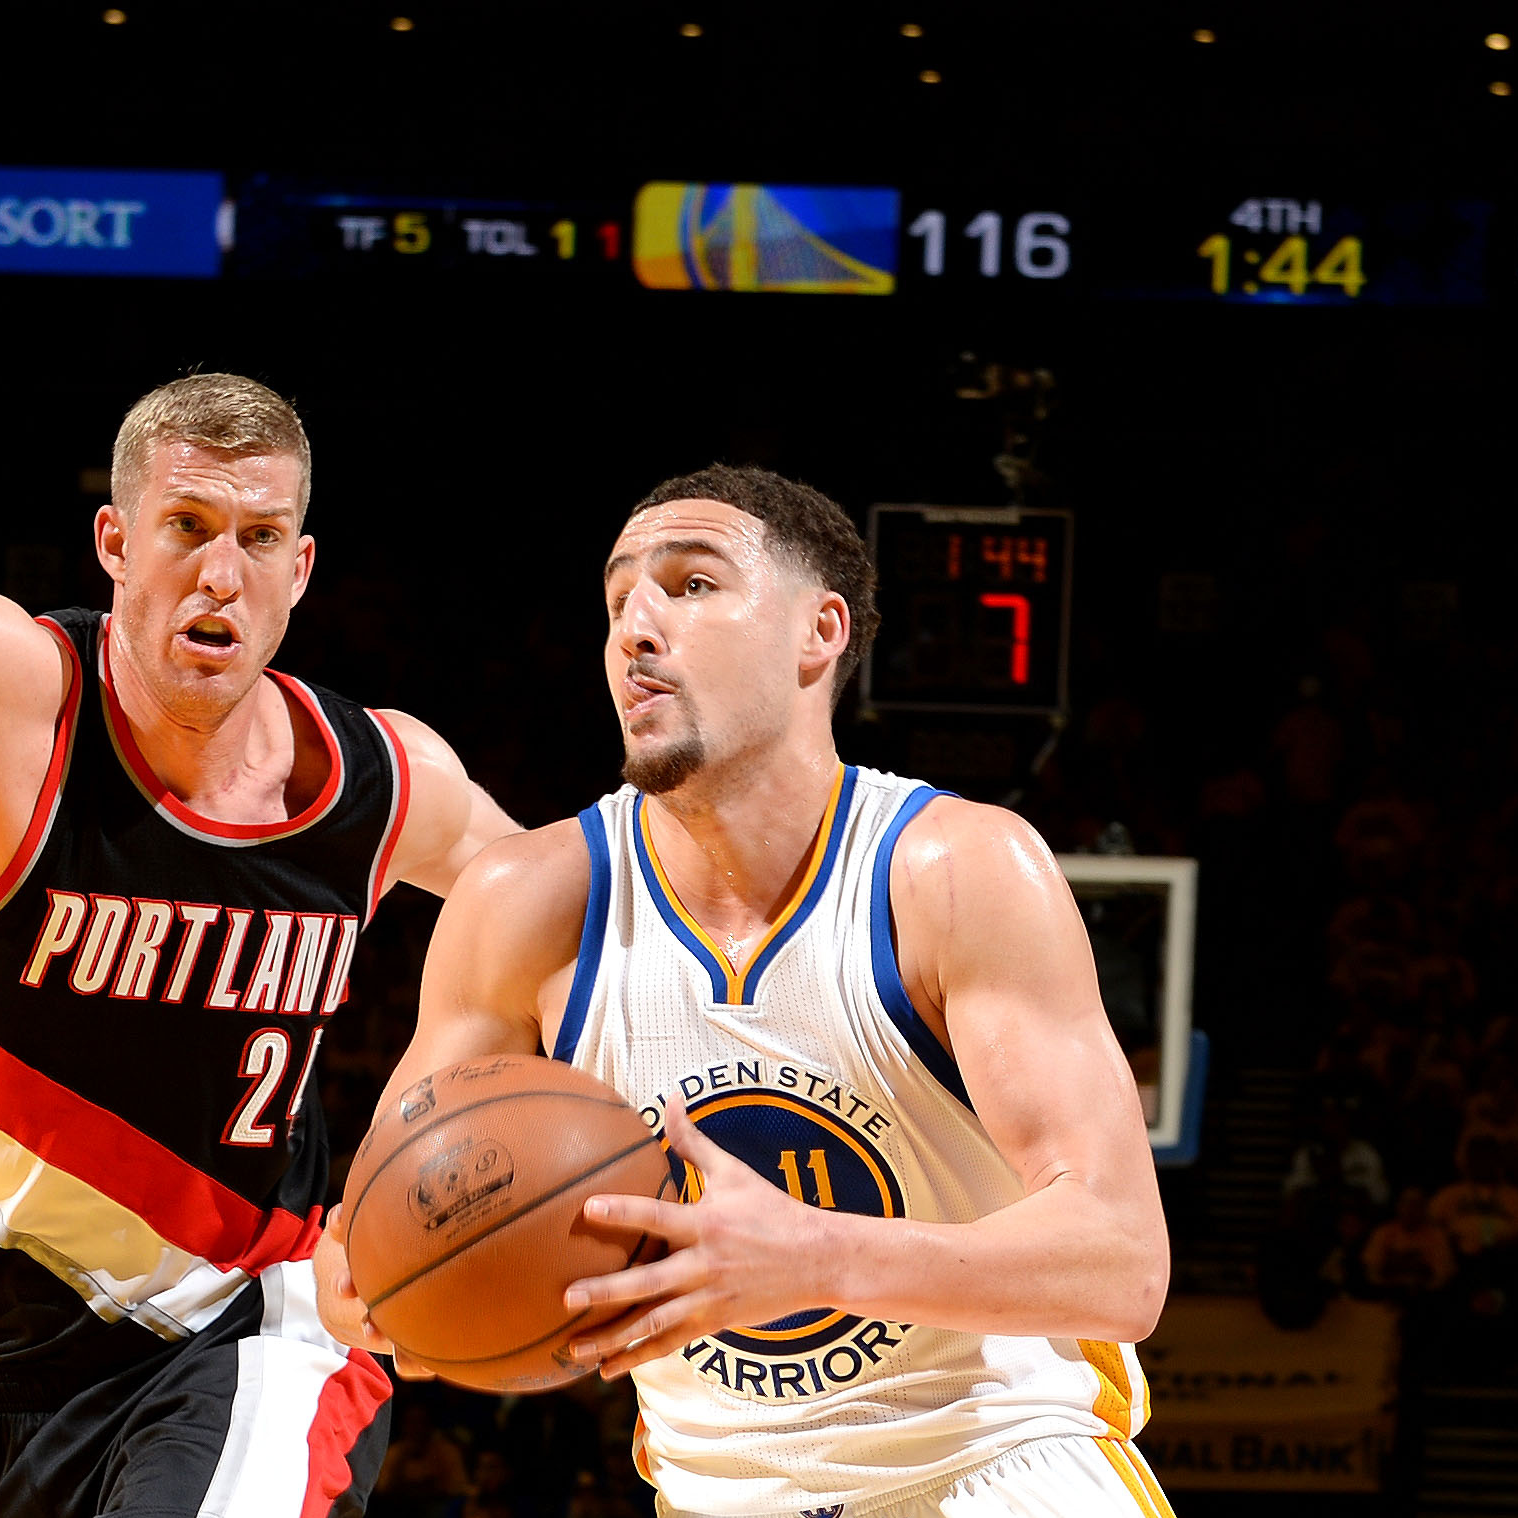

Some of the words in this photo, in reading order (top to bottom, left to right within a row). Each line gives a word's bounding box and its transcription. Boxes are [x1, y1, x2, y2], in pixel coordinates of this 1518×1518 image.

[337, 215, 386, 251] TF
[393, 212, 431, 254] 5
[462, 218, 538, 257] TOL
[551, 220, 577, 260] 1
[598, 222, 620, 260] 1
[908, 209, 1071, 279] 116
[1229, 197, 1323, 235] 4TH
[1197, 232, 1366, 298] 1:44
[980, 592, 1031, 685] 7
[777, 1066, 891, 1140] STATE
[778, 1149, 836, 1208] 11
